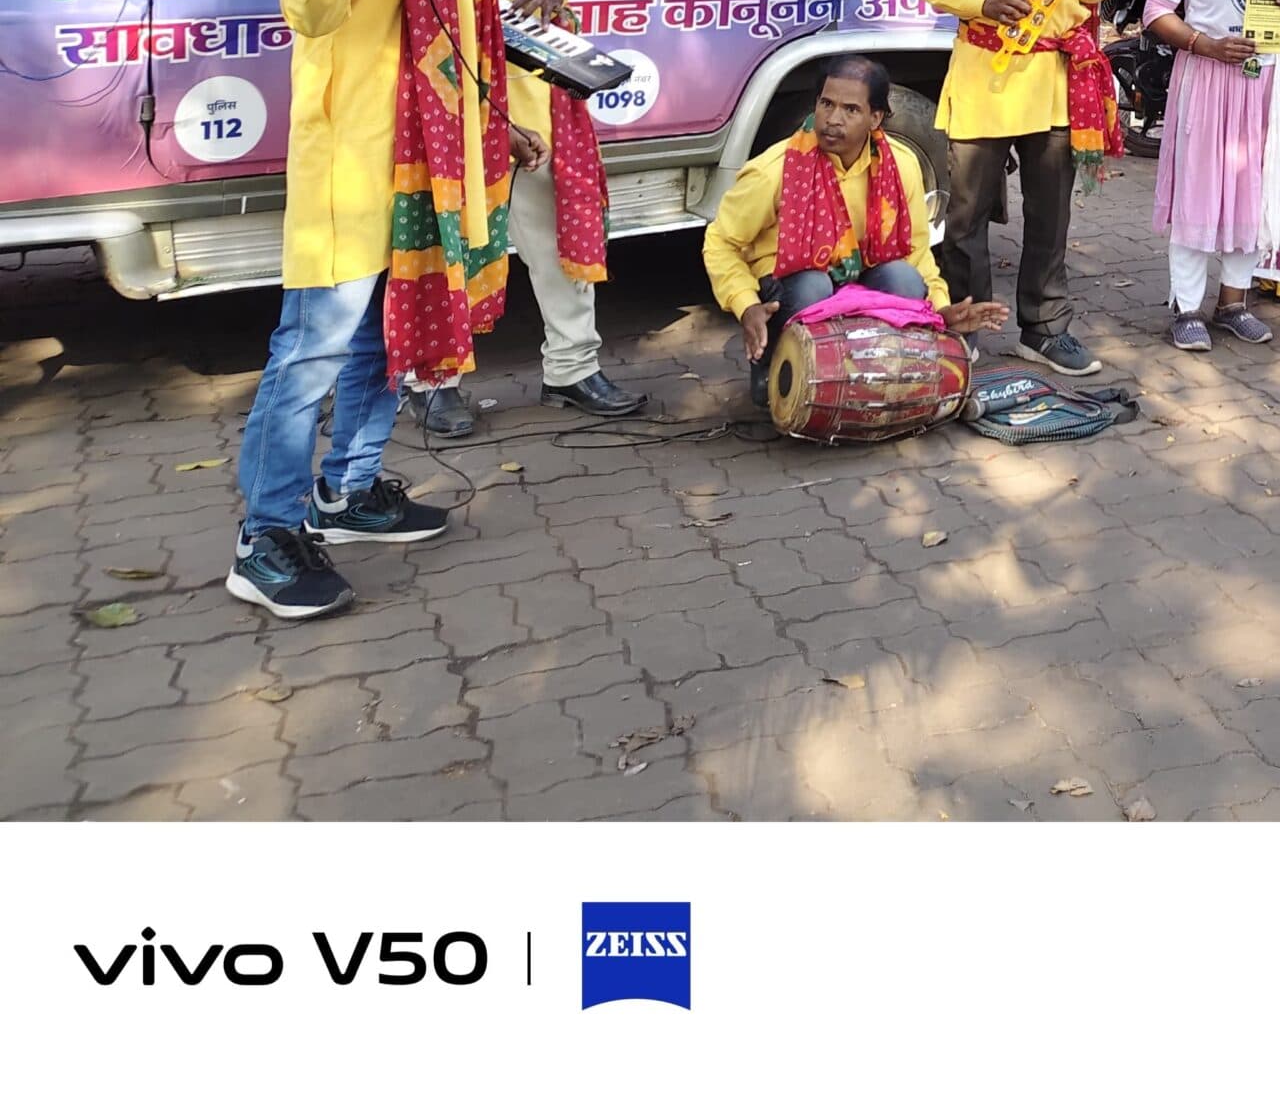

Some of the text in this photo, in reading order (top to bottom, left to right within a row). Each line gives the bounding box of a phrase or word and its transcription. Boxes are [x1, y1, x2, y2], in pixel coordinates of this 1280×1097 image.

[207, 100, 237, 115] पुलिस
[595, 89, 646, 110] 1098
[200, 118, 242, 140] 112
